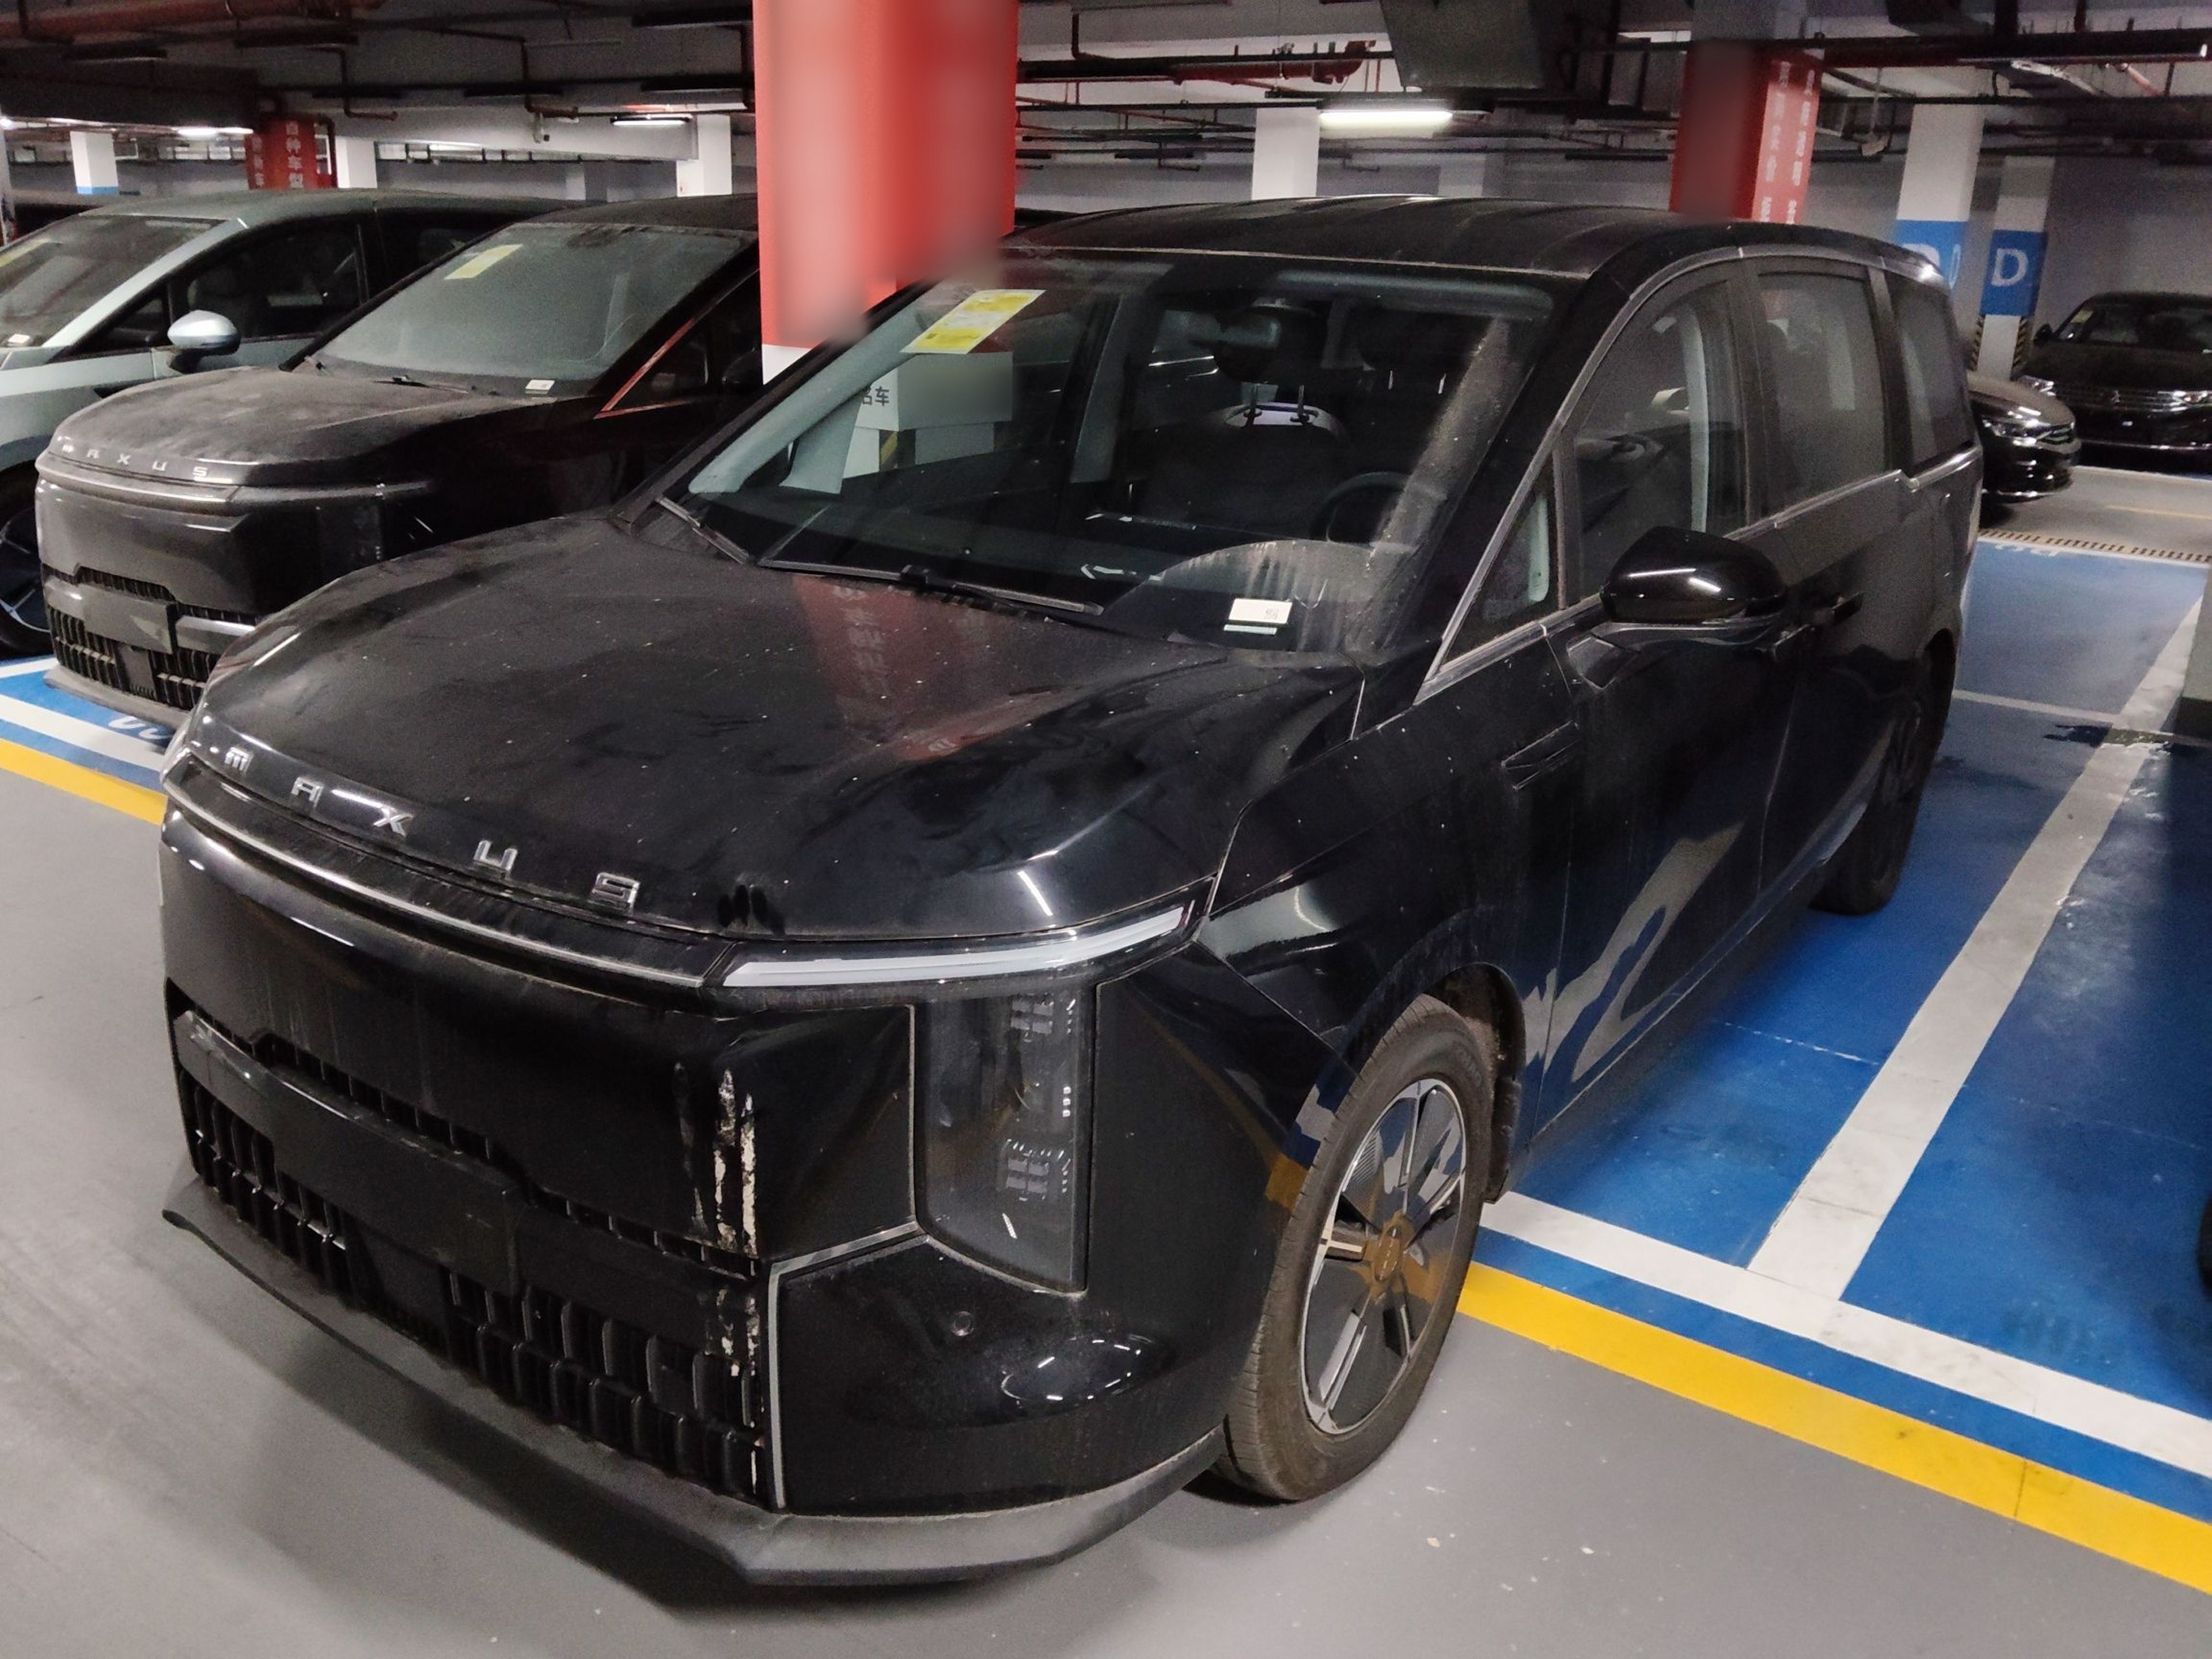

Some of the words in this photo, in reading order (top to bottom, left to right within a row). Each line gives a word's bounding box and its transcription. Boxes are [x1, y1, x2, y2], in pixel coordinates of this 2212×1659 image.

[1991, 248, 2028, 286] D
[62, 444, 208, 477] MAXUS
[224, 747, 641, 910] MAXUS
